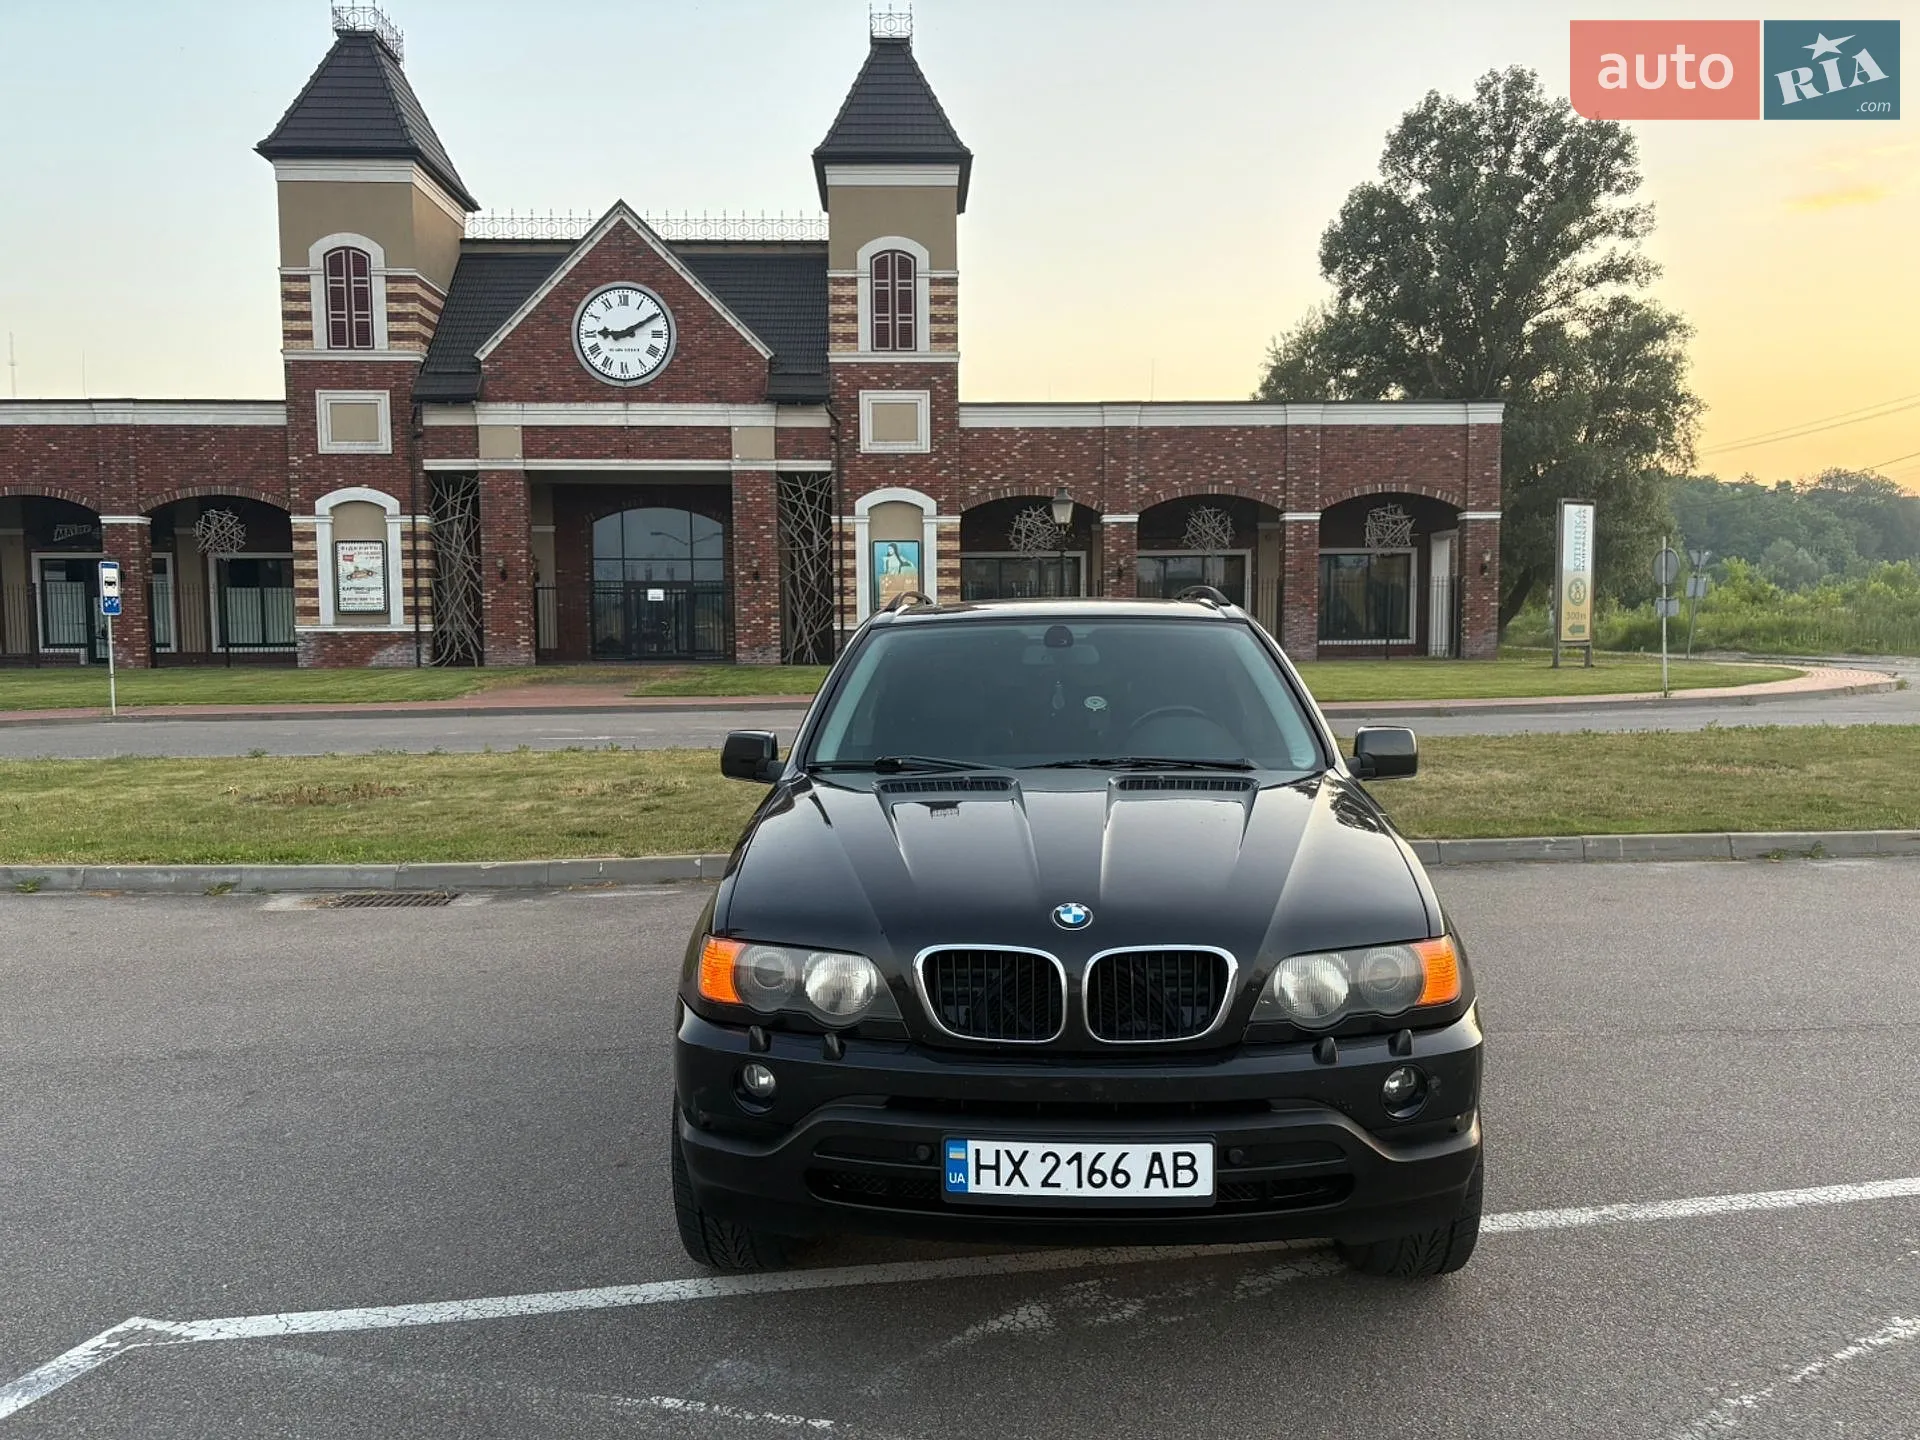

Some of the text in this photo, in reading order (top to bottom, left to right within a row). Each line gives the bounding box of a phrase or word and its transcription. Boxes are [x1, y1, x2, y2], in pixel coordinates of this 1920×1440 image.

[949, 1173, 965, 1184] UA
[974, 1148, 1199, 1189] HX 2166 AB
